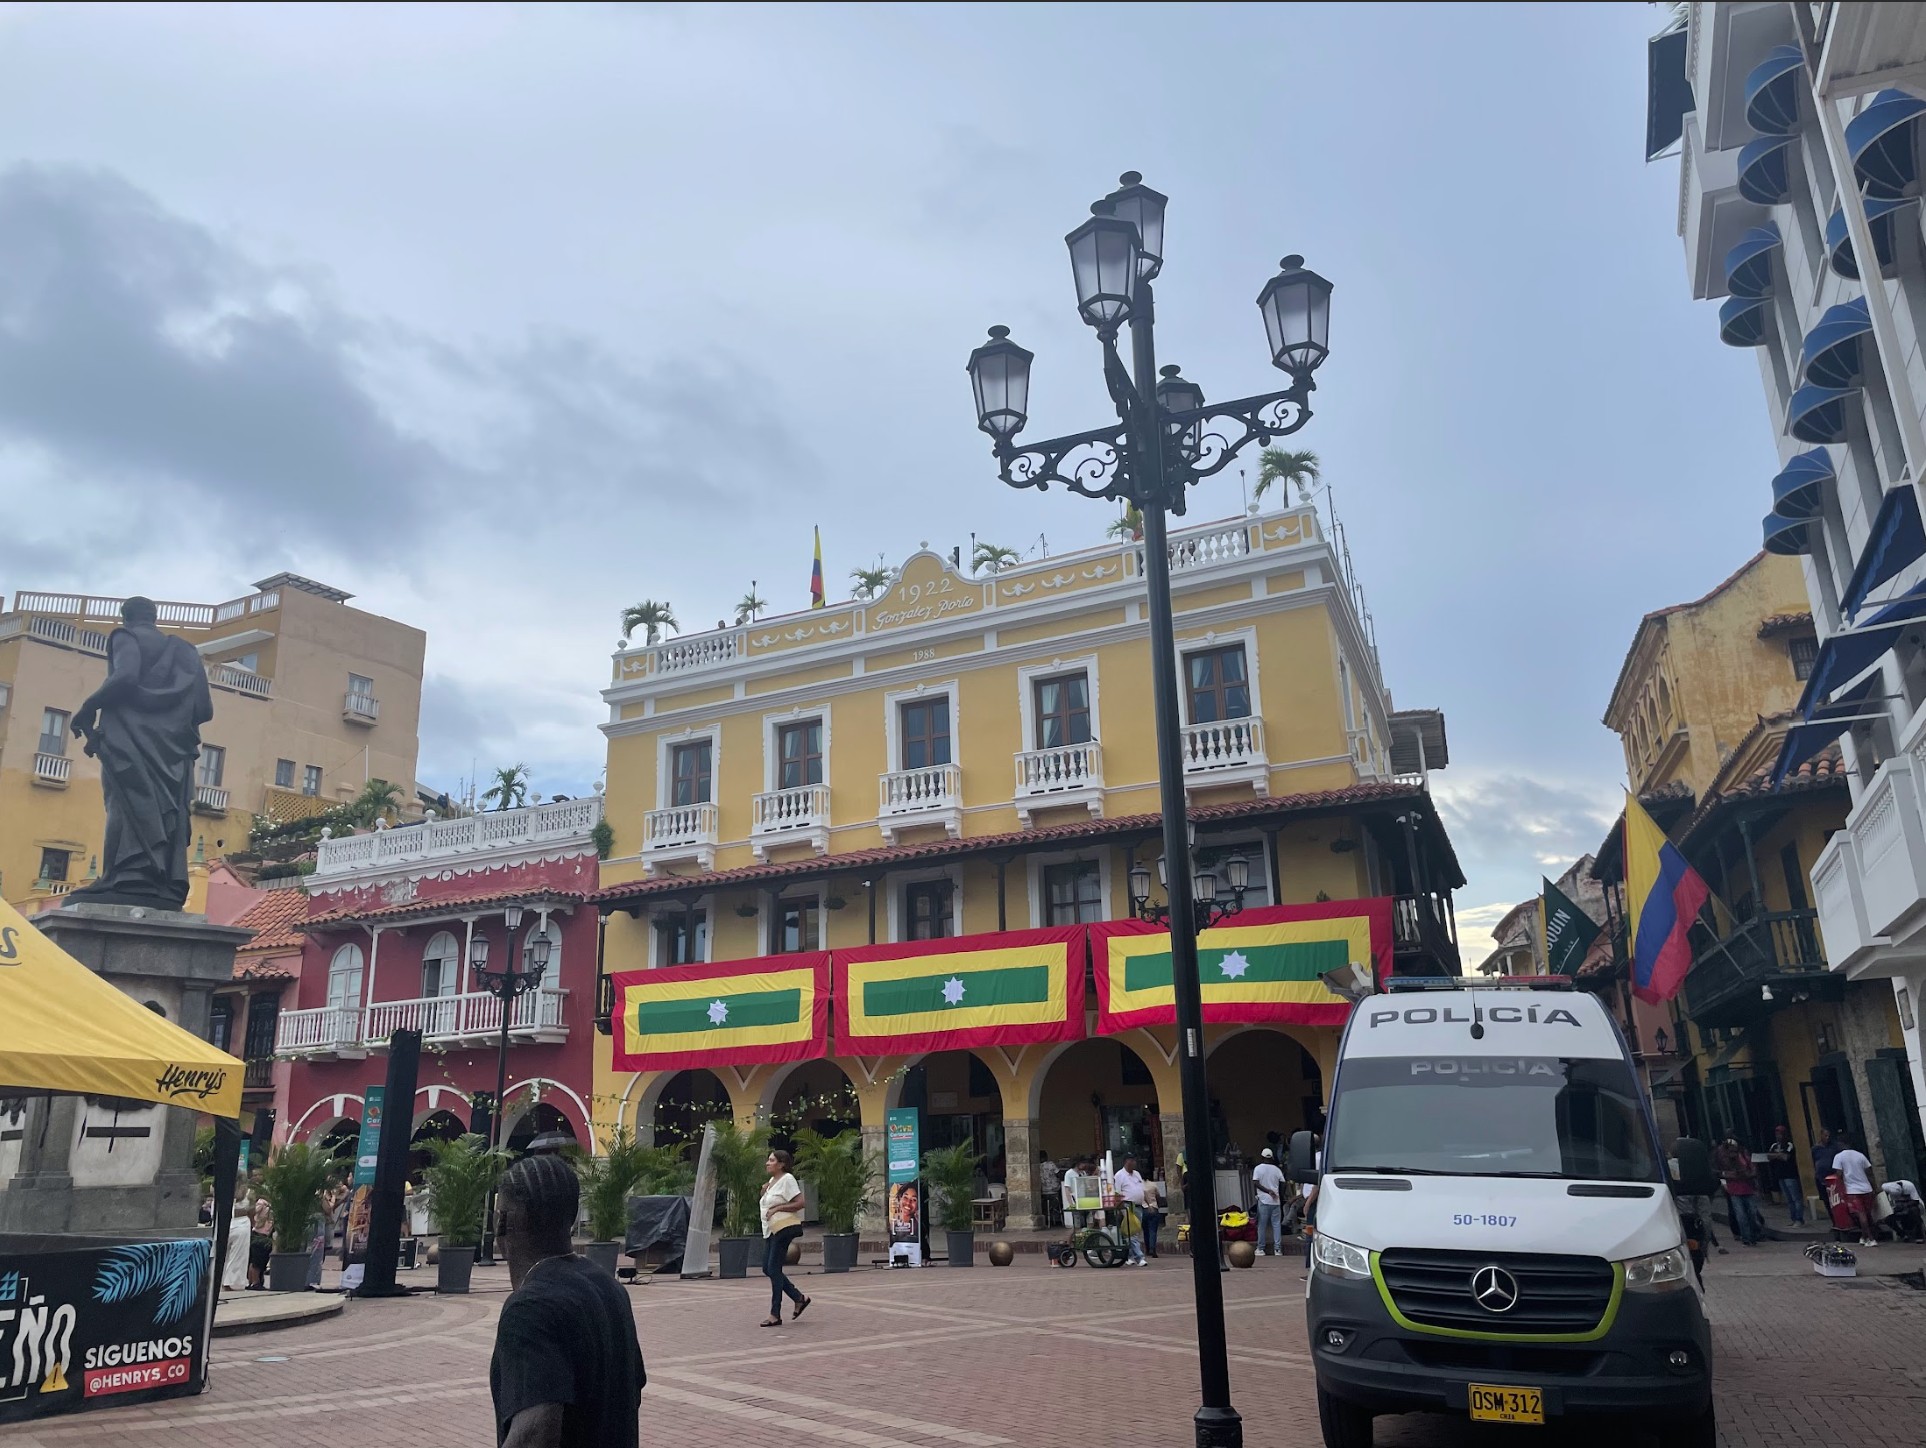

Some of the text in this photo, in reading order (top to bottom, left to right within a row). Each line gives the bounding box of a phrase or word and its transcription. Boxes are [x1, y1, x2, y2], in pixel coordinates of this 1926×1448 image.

[899, 578, 954, 605] 1922
[1370, 1003, 1582, 1028] POLICÍA
[156, 1063, 227, 1098] Henry's
[1453, 1214, 1517, 1227] 50-1807
[84, 1335, 193, 1369] SIGUENOS
[89, 1364, 186, 1393] @HENRYS_CO
